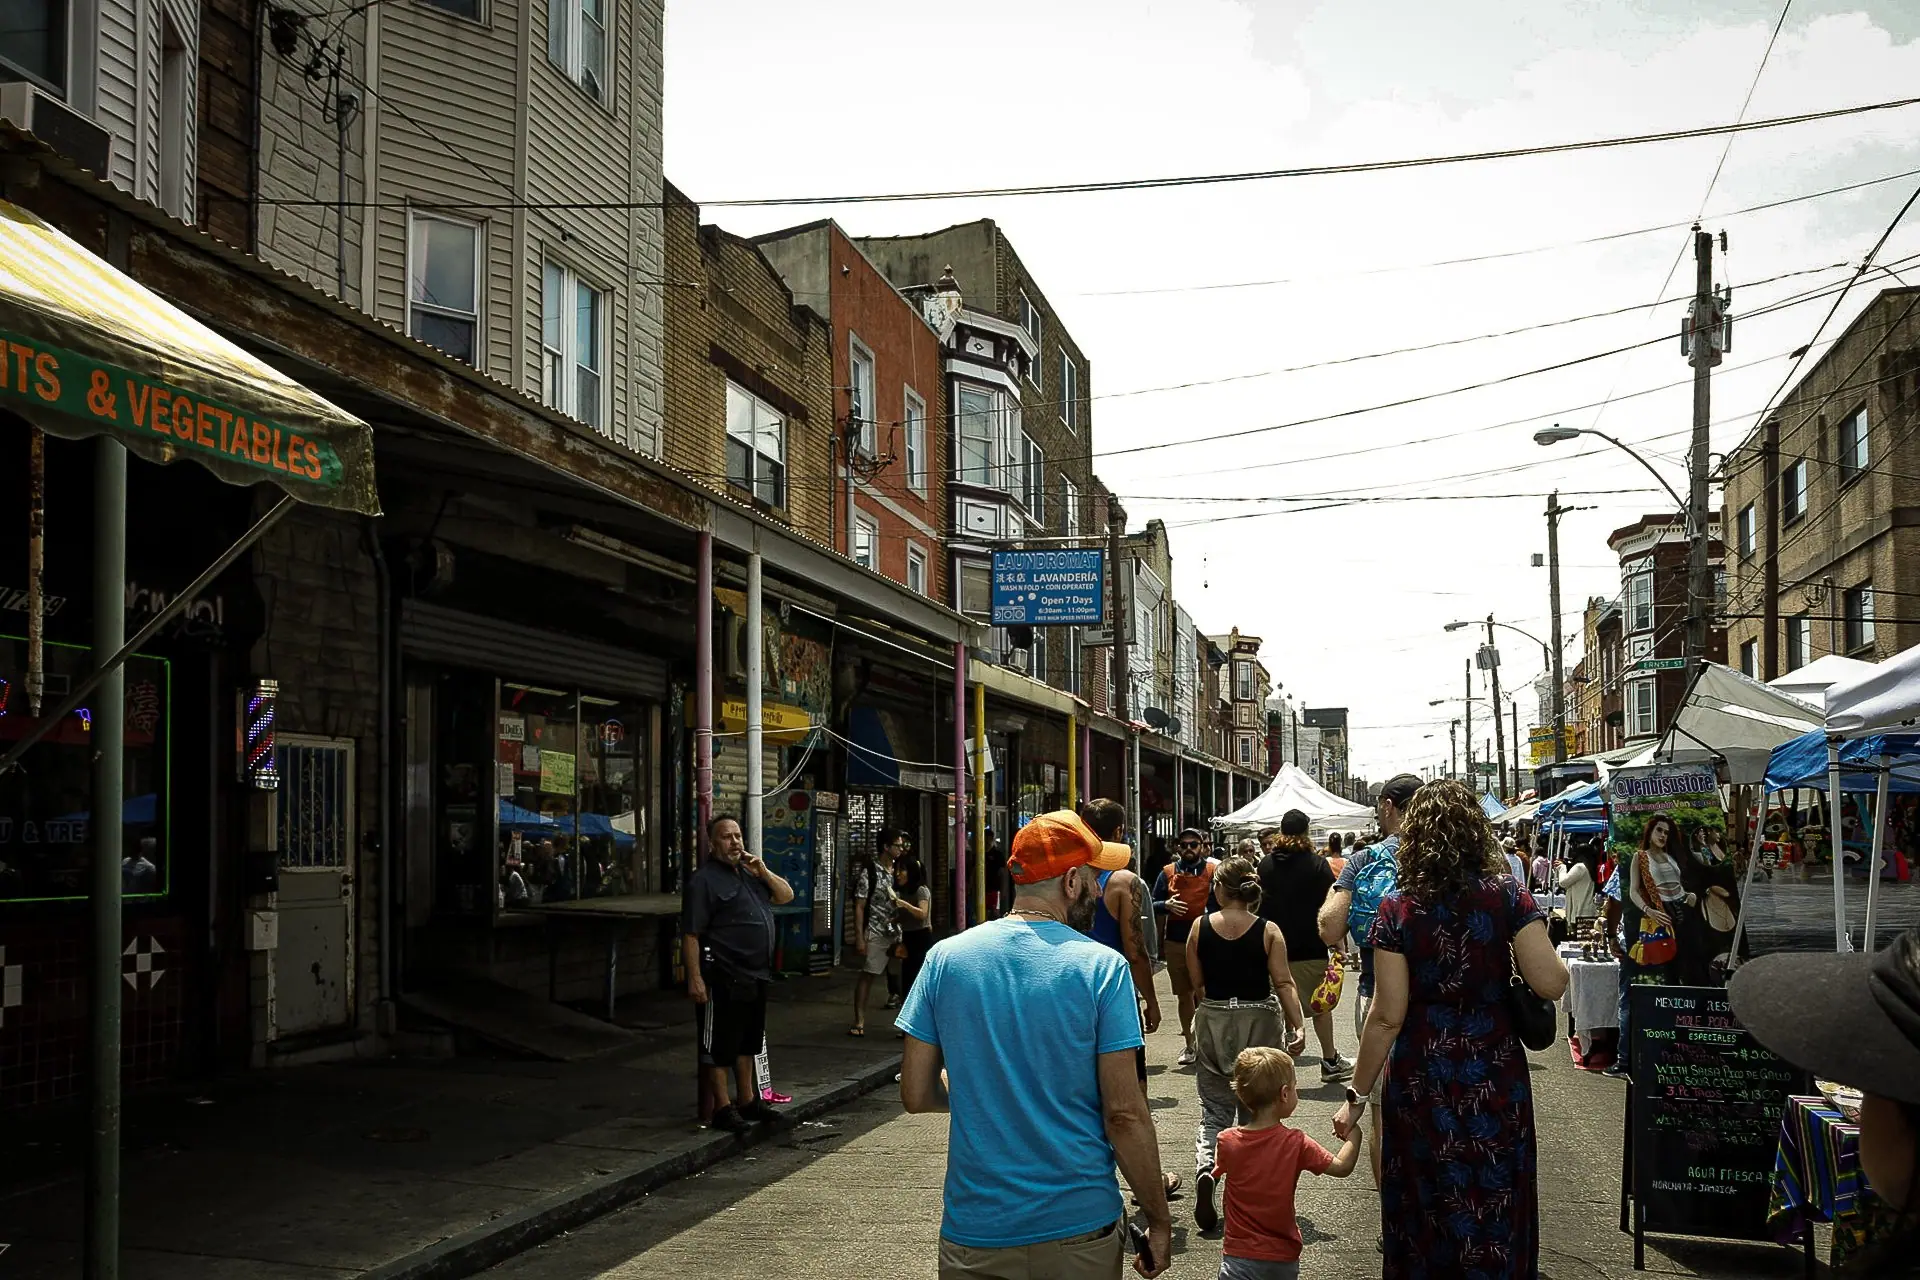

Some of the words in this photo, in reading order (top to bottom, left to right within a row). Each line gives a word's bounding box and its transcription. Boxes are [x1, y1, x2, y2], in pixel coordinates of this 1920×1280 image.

[86, 369, 117, 421] &
[125, 379, 322, 480] VEGETABLES
[995, 551, 1100, 571] LAUNDROMAT
[1033, 570, 1098, 583] LAVANDERÍA
[1062, 583, 1094, 591] OPERATED
[1041, 596, 1064, 606] Open
[1065, 596, 1071, 604] 7
[1073, 595, 1093, 606] Days
[1068, 606, 1096, 614] 11:00pm
[1643, 661, 1669, 669] ERNST
[1614, 774, 1715, 799] @Venbisustore
[1655, 997, 1697, 1010] MEXICAN
[1675, 1015, 1702, 1027] MOLE
[1643, 1028, 1677, 1040] TODAYS
[1688, 1032, 1737, 1043] ESPECIALES
[1654, 1063, 1688, 1076] WITH
[1691, 1064, 1721, 1077] SALSA
[1759, 1068, 1792, 1082] GALLO
[1657, 1074, 1681, 1085] AND
[1684, 1076, 1711, 1087] SOUR
[1712, 1078, 1748, 1089] CREAM
[1691, 1086, 1723, 1098] TACOS
[1687, 1166, 1716, 1179] AGUA
[1719, 1168, 1764, 1183] FRESCA
[1651, 1179, 1692, 1192] HORCHATA
